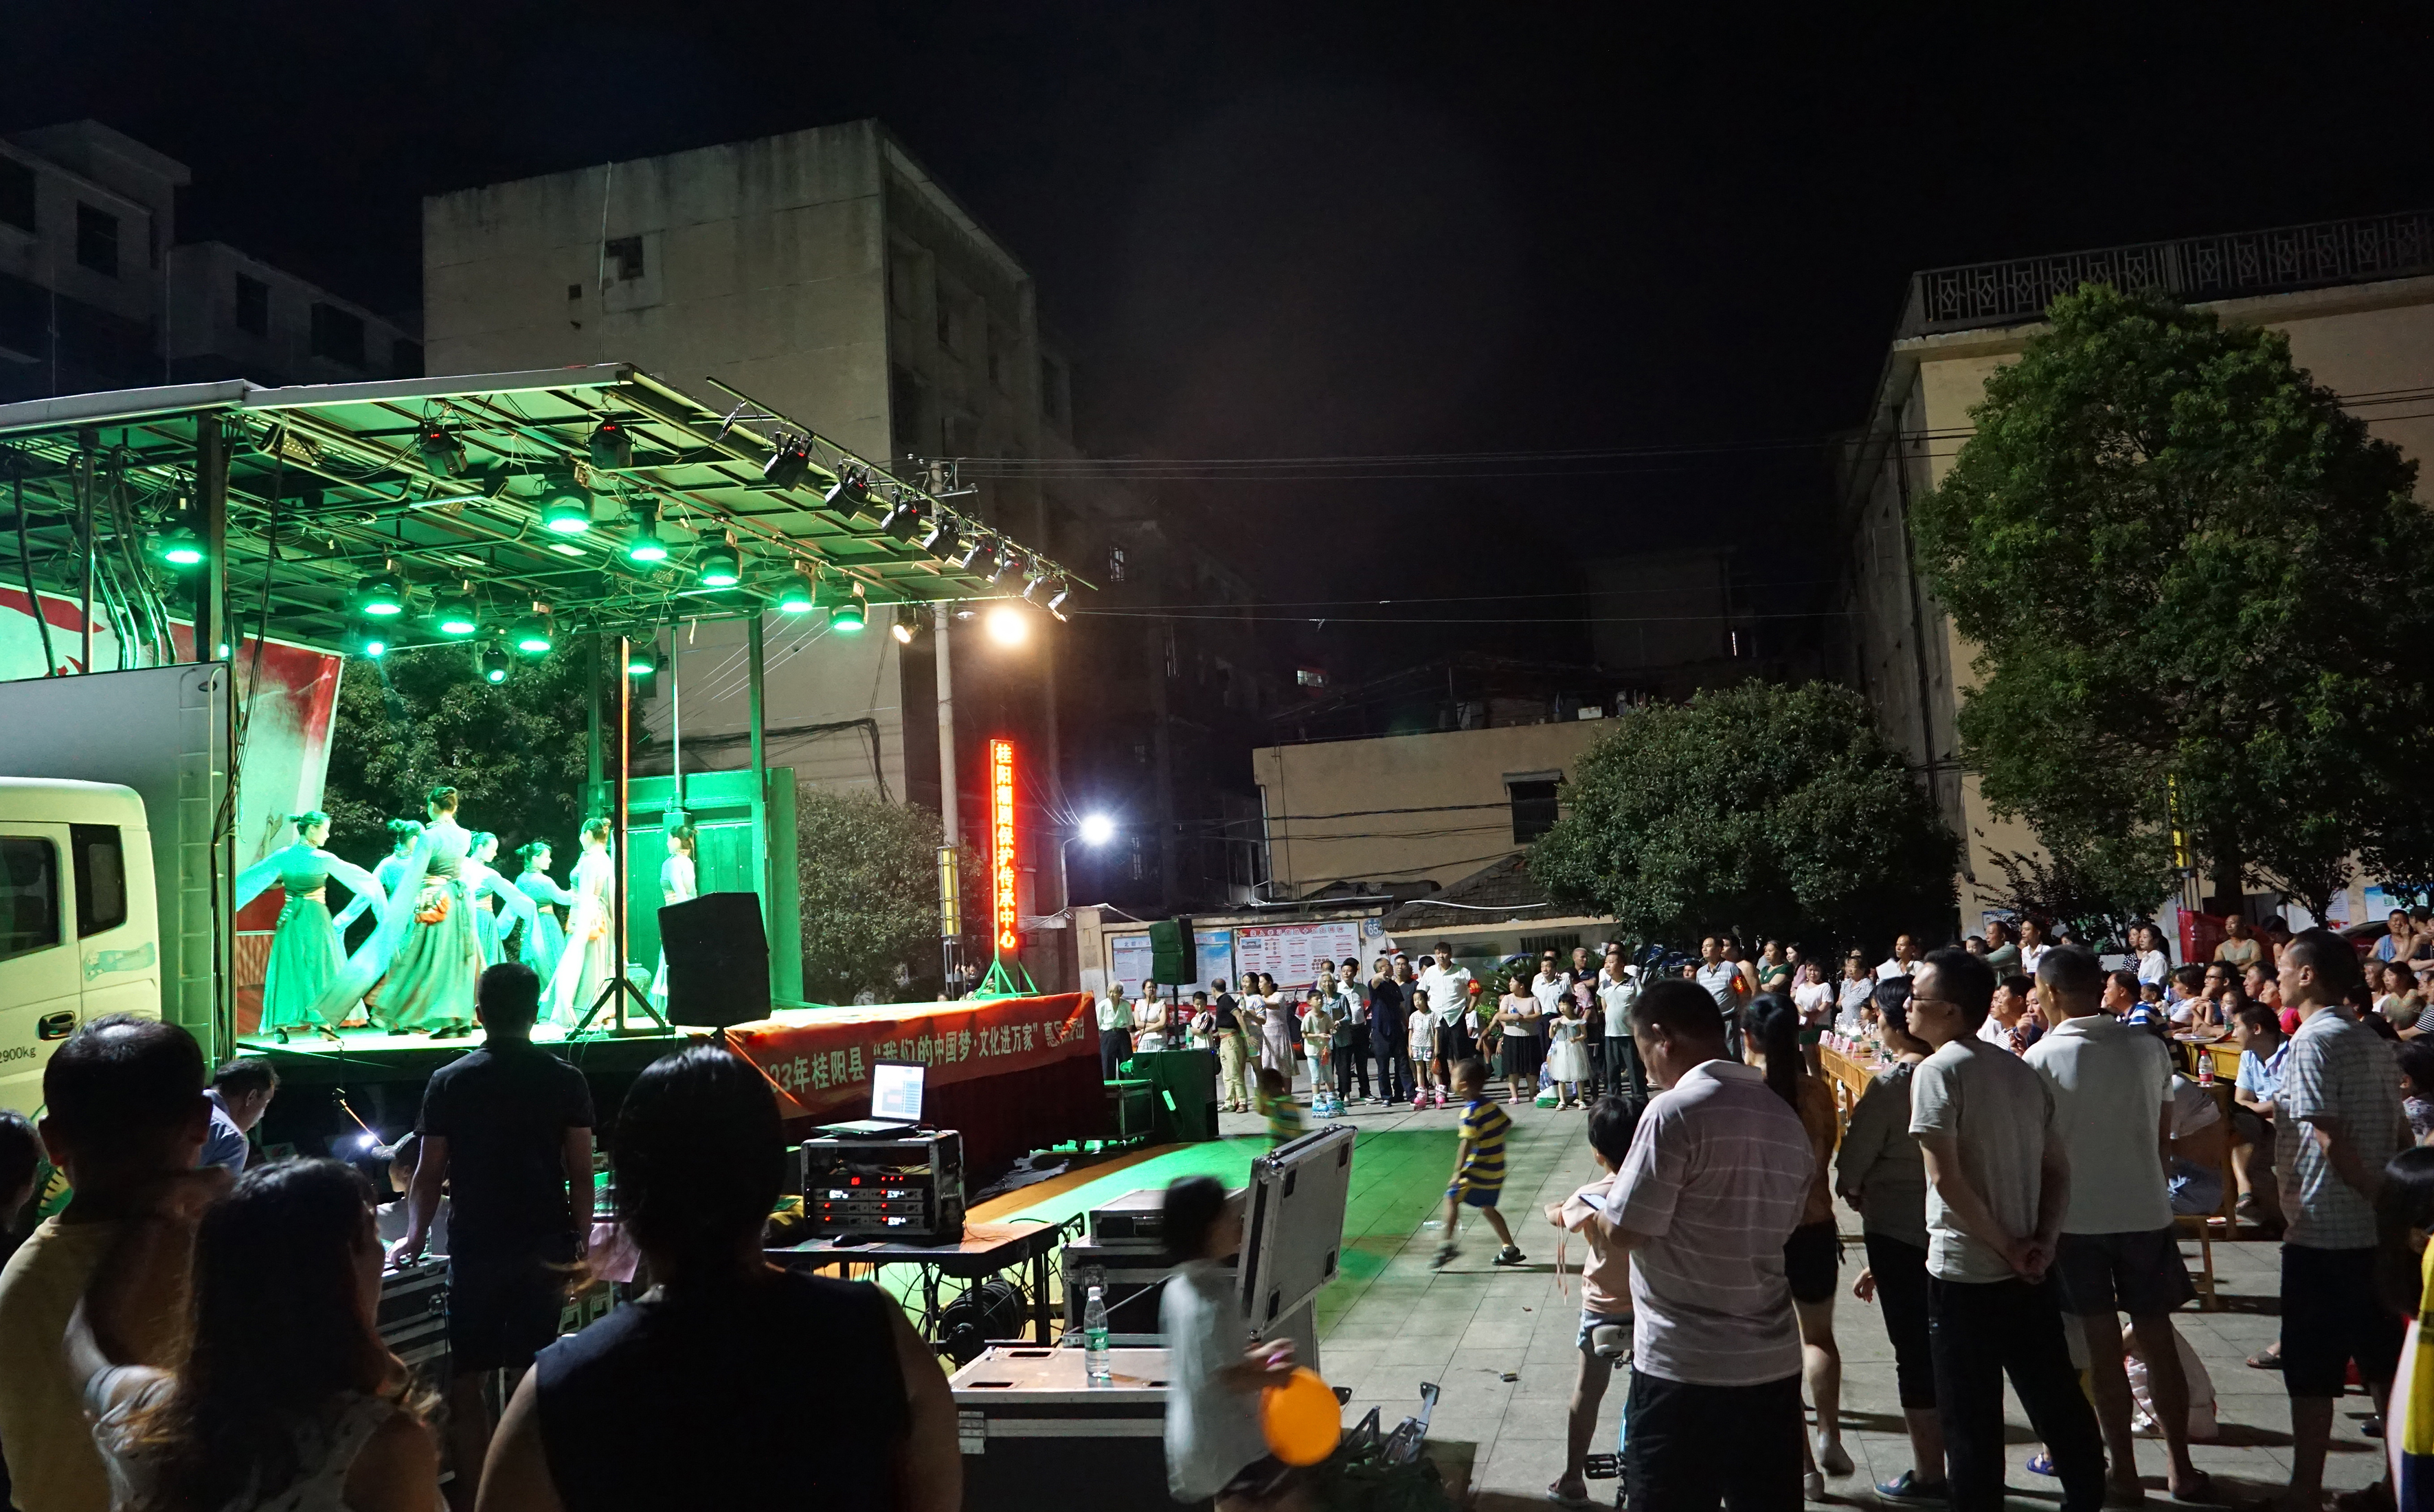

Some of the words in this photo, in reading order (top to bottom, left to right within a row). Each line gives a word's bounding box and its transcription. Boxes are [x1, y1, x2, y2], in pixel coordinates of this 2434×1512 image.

[995, 743, 1016, 948] 桂阳湘剧保护传承中心
[760, 1046, 866, 1094] 23年桂阳县
